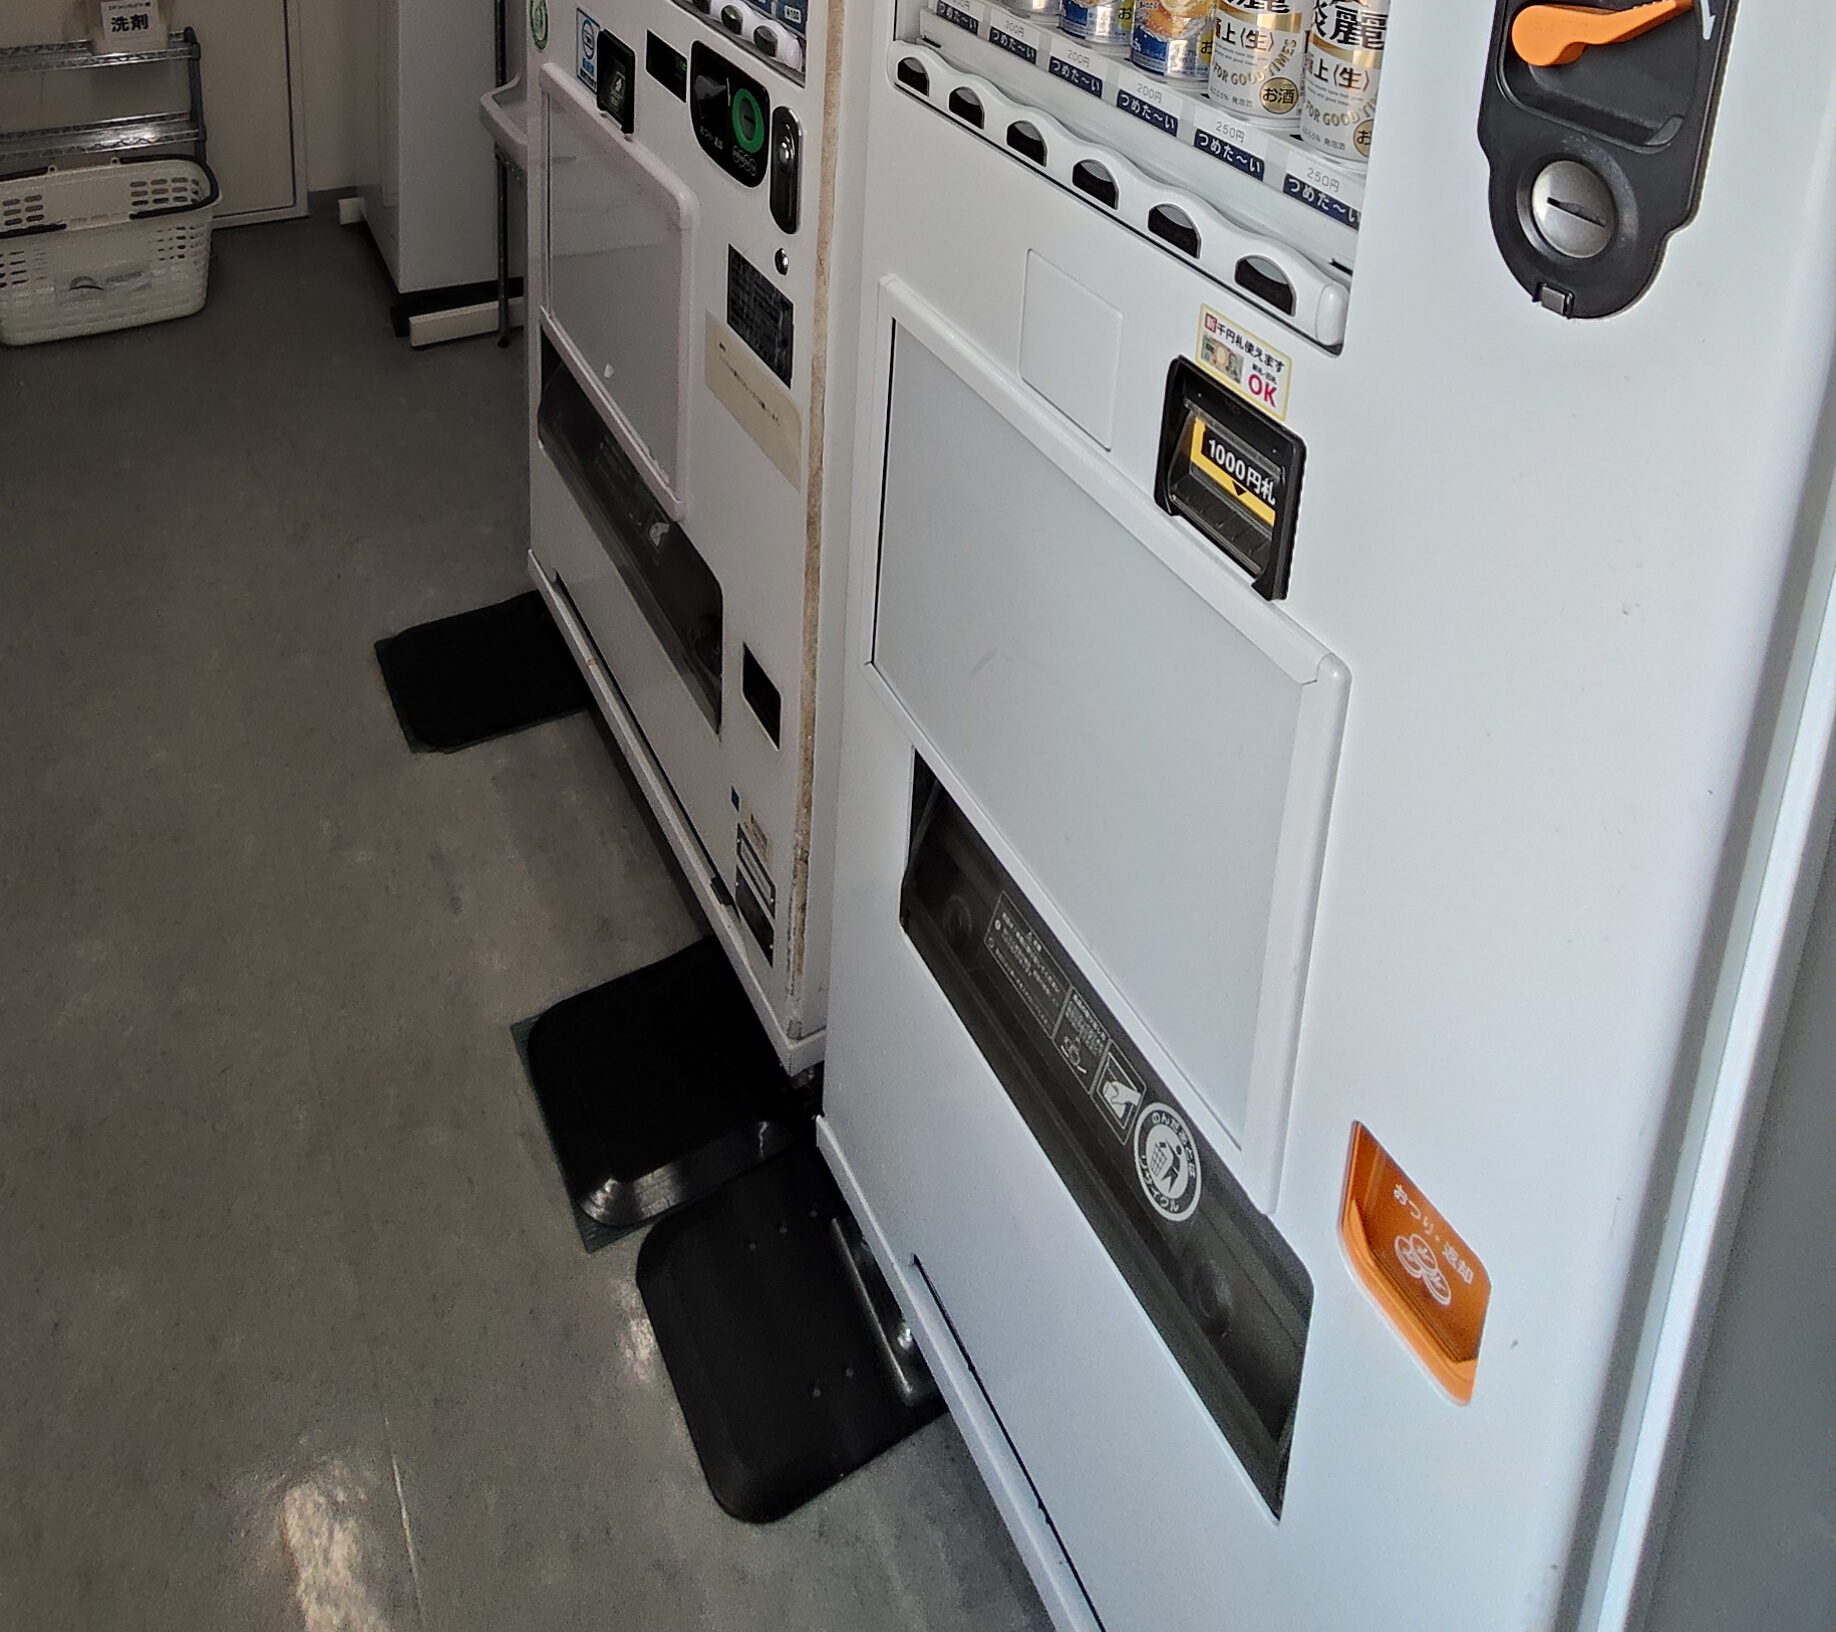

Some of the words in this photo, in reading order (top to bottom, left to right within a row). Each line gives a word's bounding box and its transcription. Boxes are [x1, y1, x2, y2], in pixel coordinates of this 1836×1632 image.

[111, 13, 150, 33] 洗剤
[1118, 6, 1133, 21] お
[1004, 19, 1025, 38] 300円
[1066, 49, 1090, 68] 200円
[1212, 60, 1229, 84] FOR
[1230, 70, 1266, 86] GOOD
[1268, 38, 1298, 77] TIMES
[1136, 82, 1162, 104] 200円
[1262, 87, 1296, 105] お酒
[1119, 93, 1176, 130] つめた～い
[1306, 99, 1321, 123] FOR
[1322, 110, 1361, 127] GOOD
[1215, 121, 1246, 144] 250円
[1356, 129, 1372, 146] お
[1198, 132, 1261, 174] つめた～い
[1306, 167, 1341, 194] 250円
[1247, 373, 1278, 408] OK
[1207, 438, 1276, 506] 1000円札
[1151, 1111, 1197, 1179] のんだあとは
[1140, 1154, 1180, 1213] リサイクル
